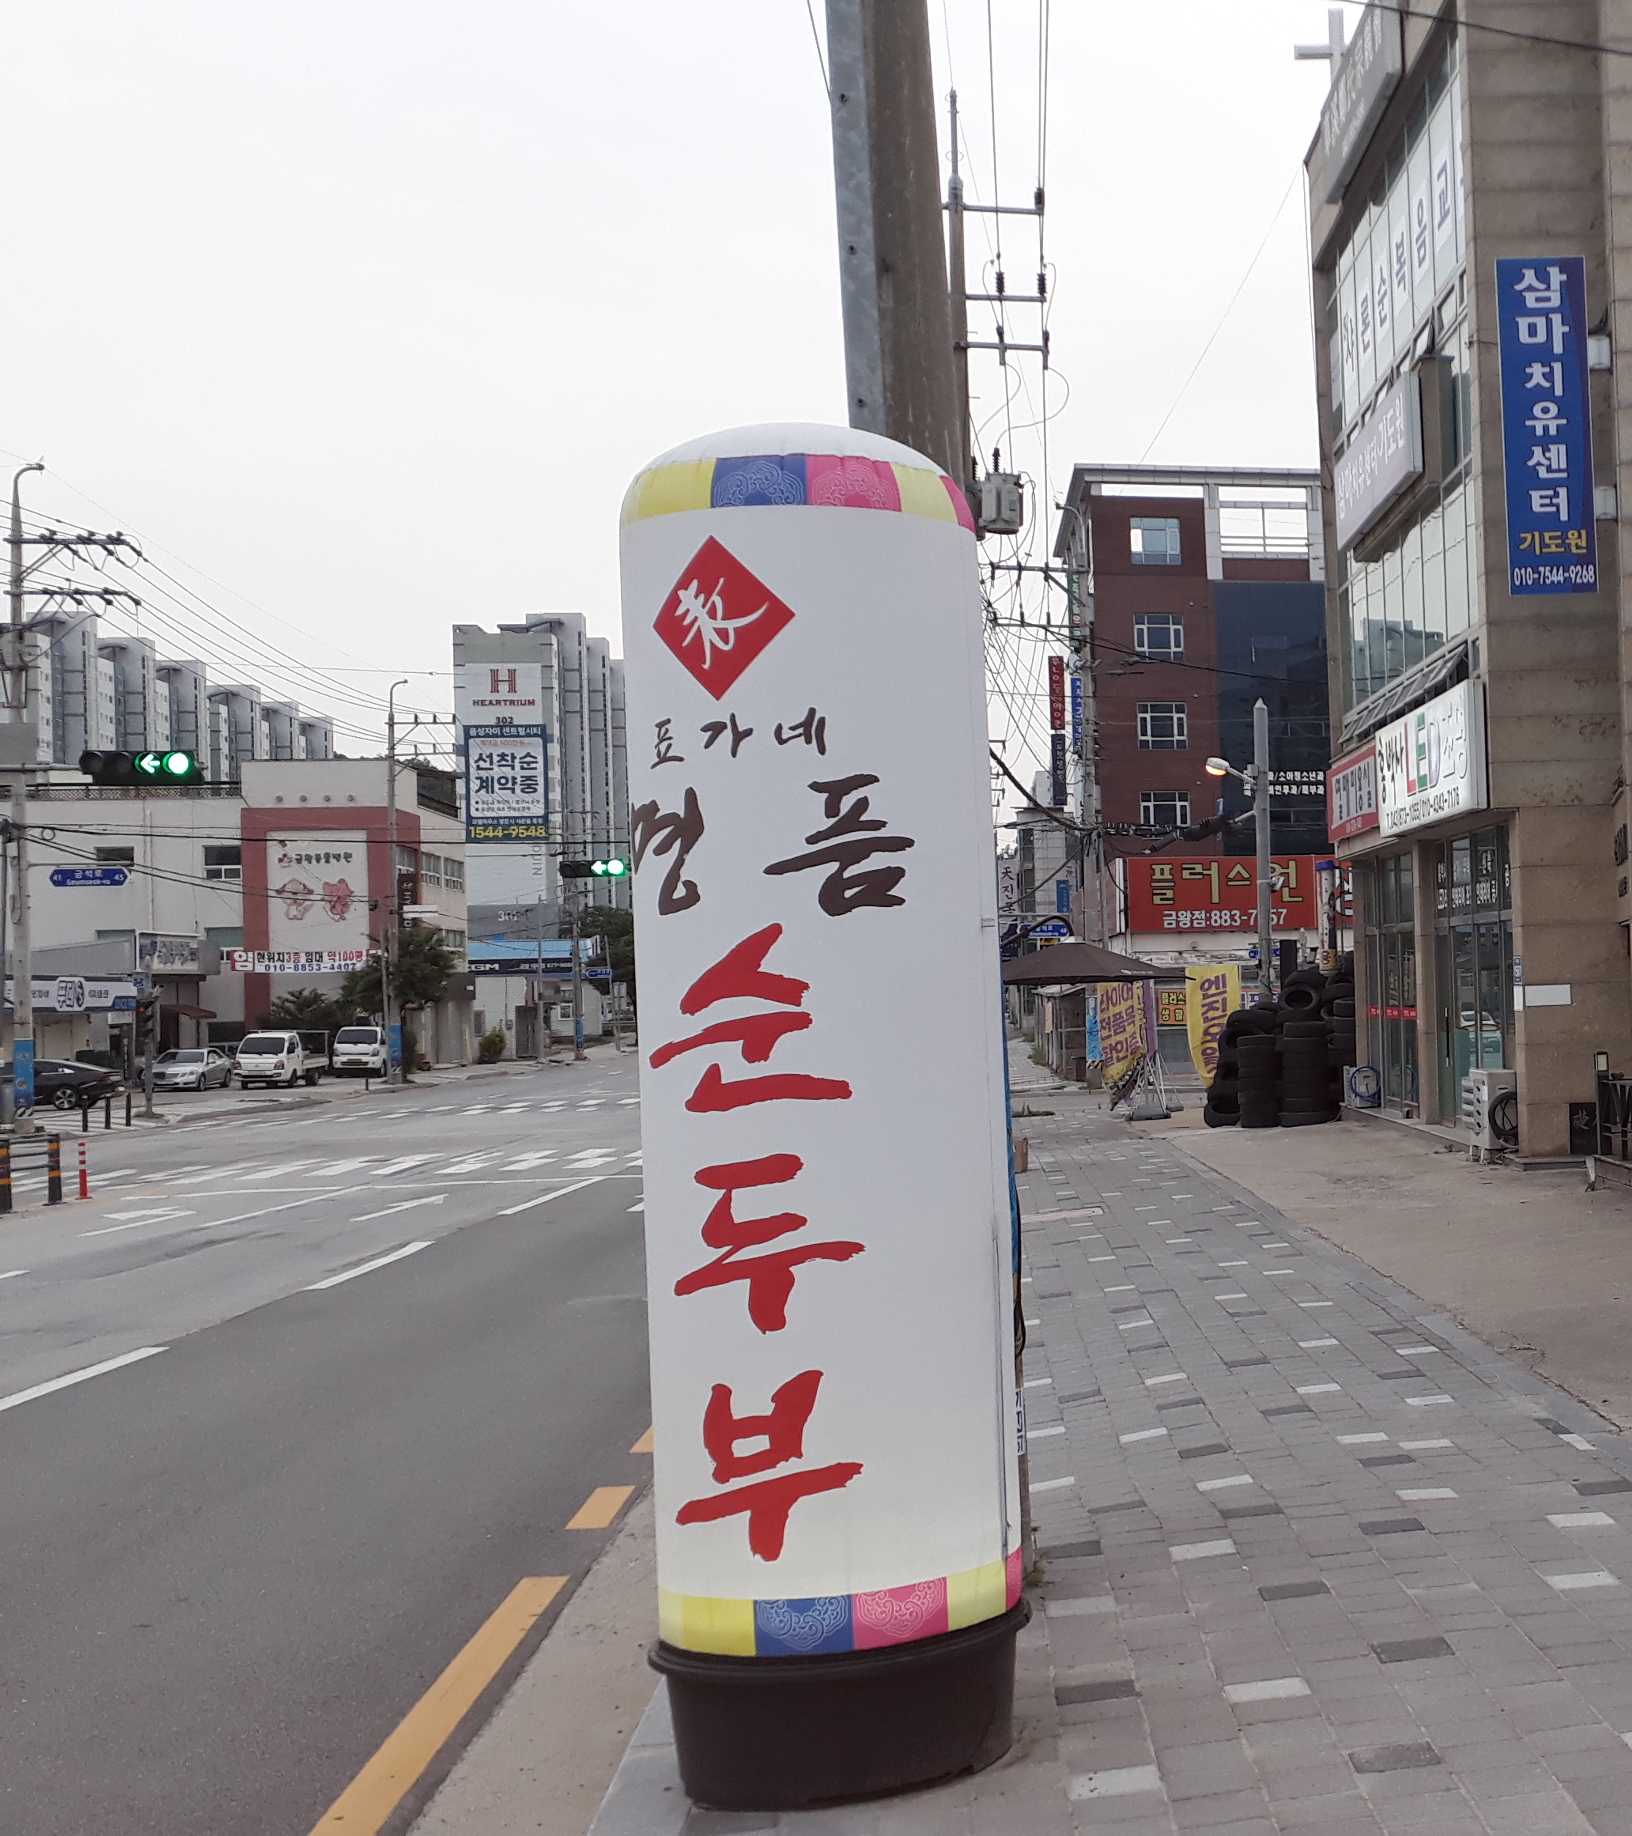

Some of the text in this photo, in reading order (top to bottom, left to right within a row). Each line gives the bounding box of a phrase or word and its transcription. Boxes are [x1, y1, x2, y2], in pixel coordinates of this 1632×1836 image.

[1513, 266, 1571, 523] 삼마치유센터
[1518, 530, 1588, 556] 기도원
[1513, 564, 1596, 586] 010-7544-9268
[495, 716, 514, 725] 302
[650, 707, 827, 770] 표가네
[474, 751, 539, 771] 선착순
[474, 775, 539, 795] 계약중
[469, 826, 546, 839] 1544-9548
[1163, 908, 1288, 929] 금왕점:883-757
[305, 951, 323, 963] 임대
[650, 921, 866, 1562] 순두부
